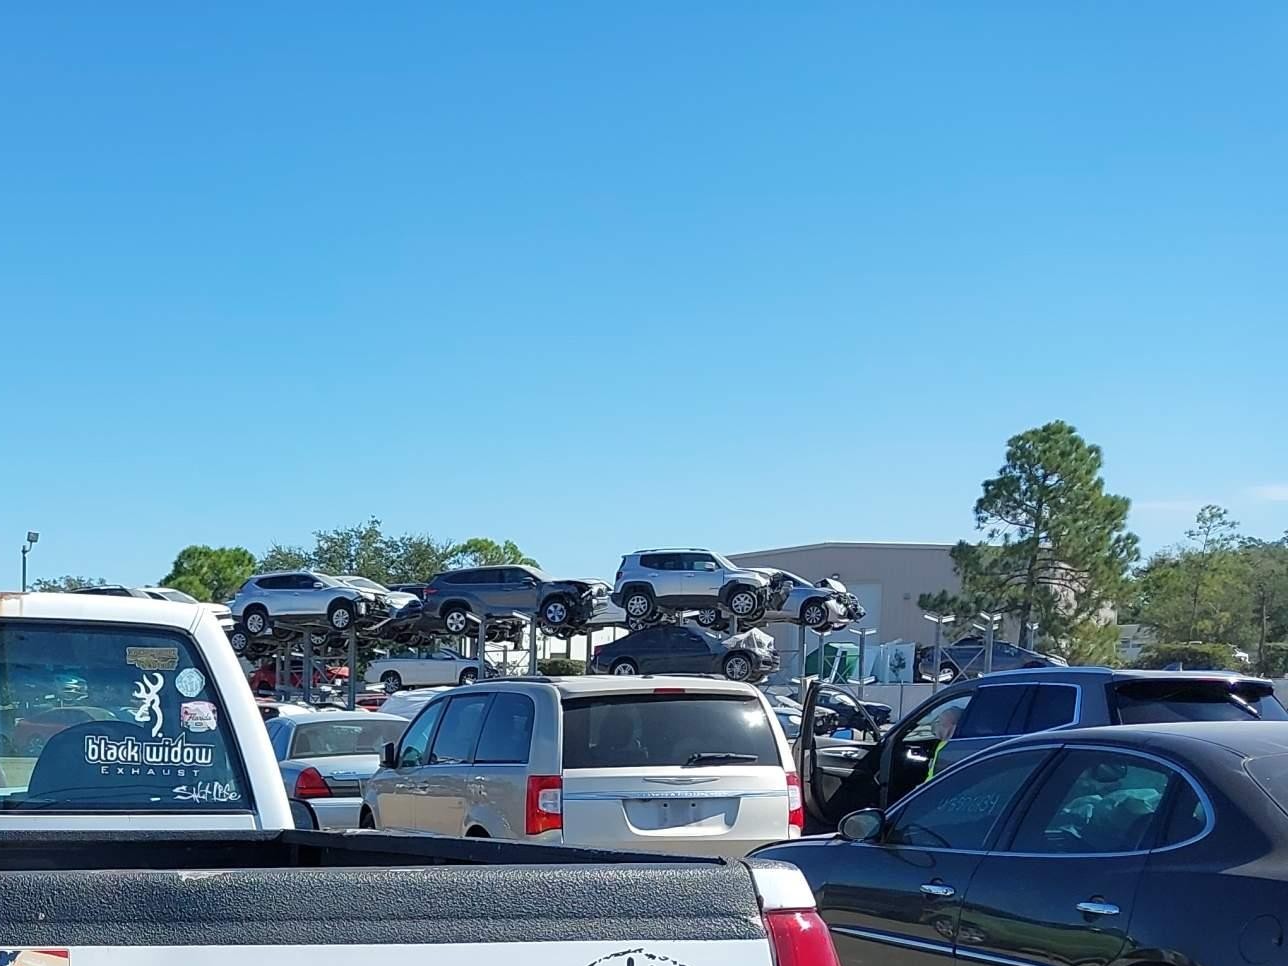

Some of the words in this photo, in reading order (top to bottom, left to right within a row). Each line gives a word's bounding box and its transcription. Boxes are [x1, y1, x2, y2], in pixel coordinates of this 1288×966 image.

[86, 736, 141, 764] black
[144, 734, 214, 765] widow
[100, 766, 200, 776] EXHAUST
